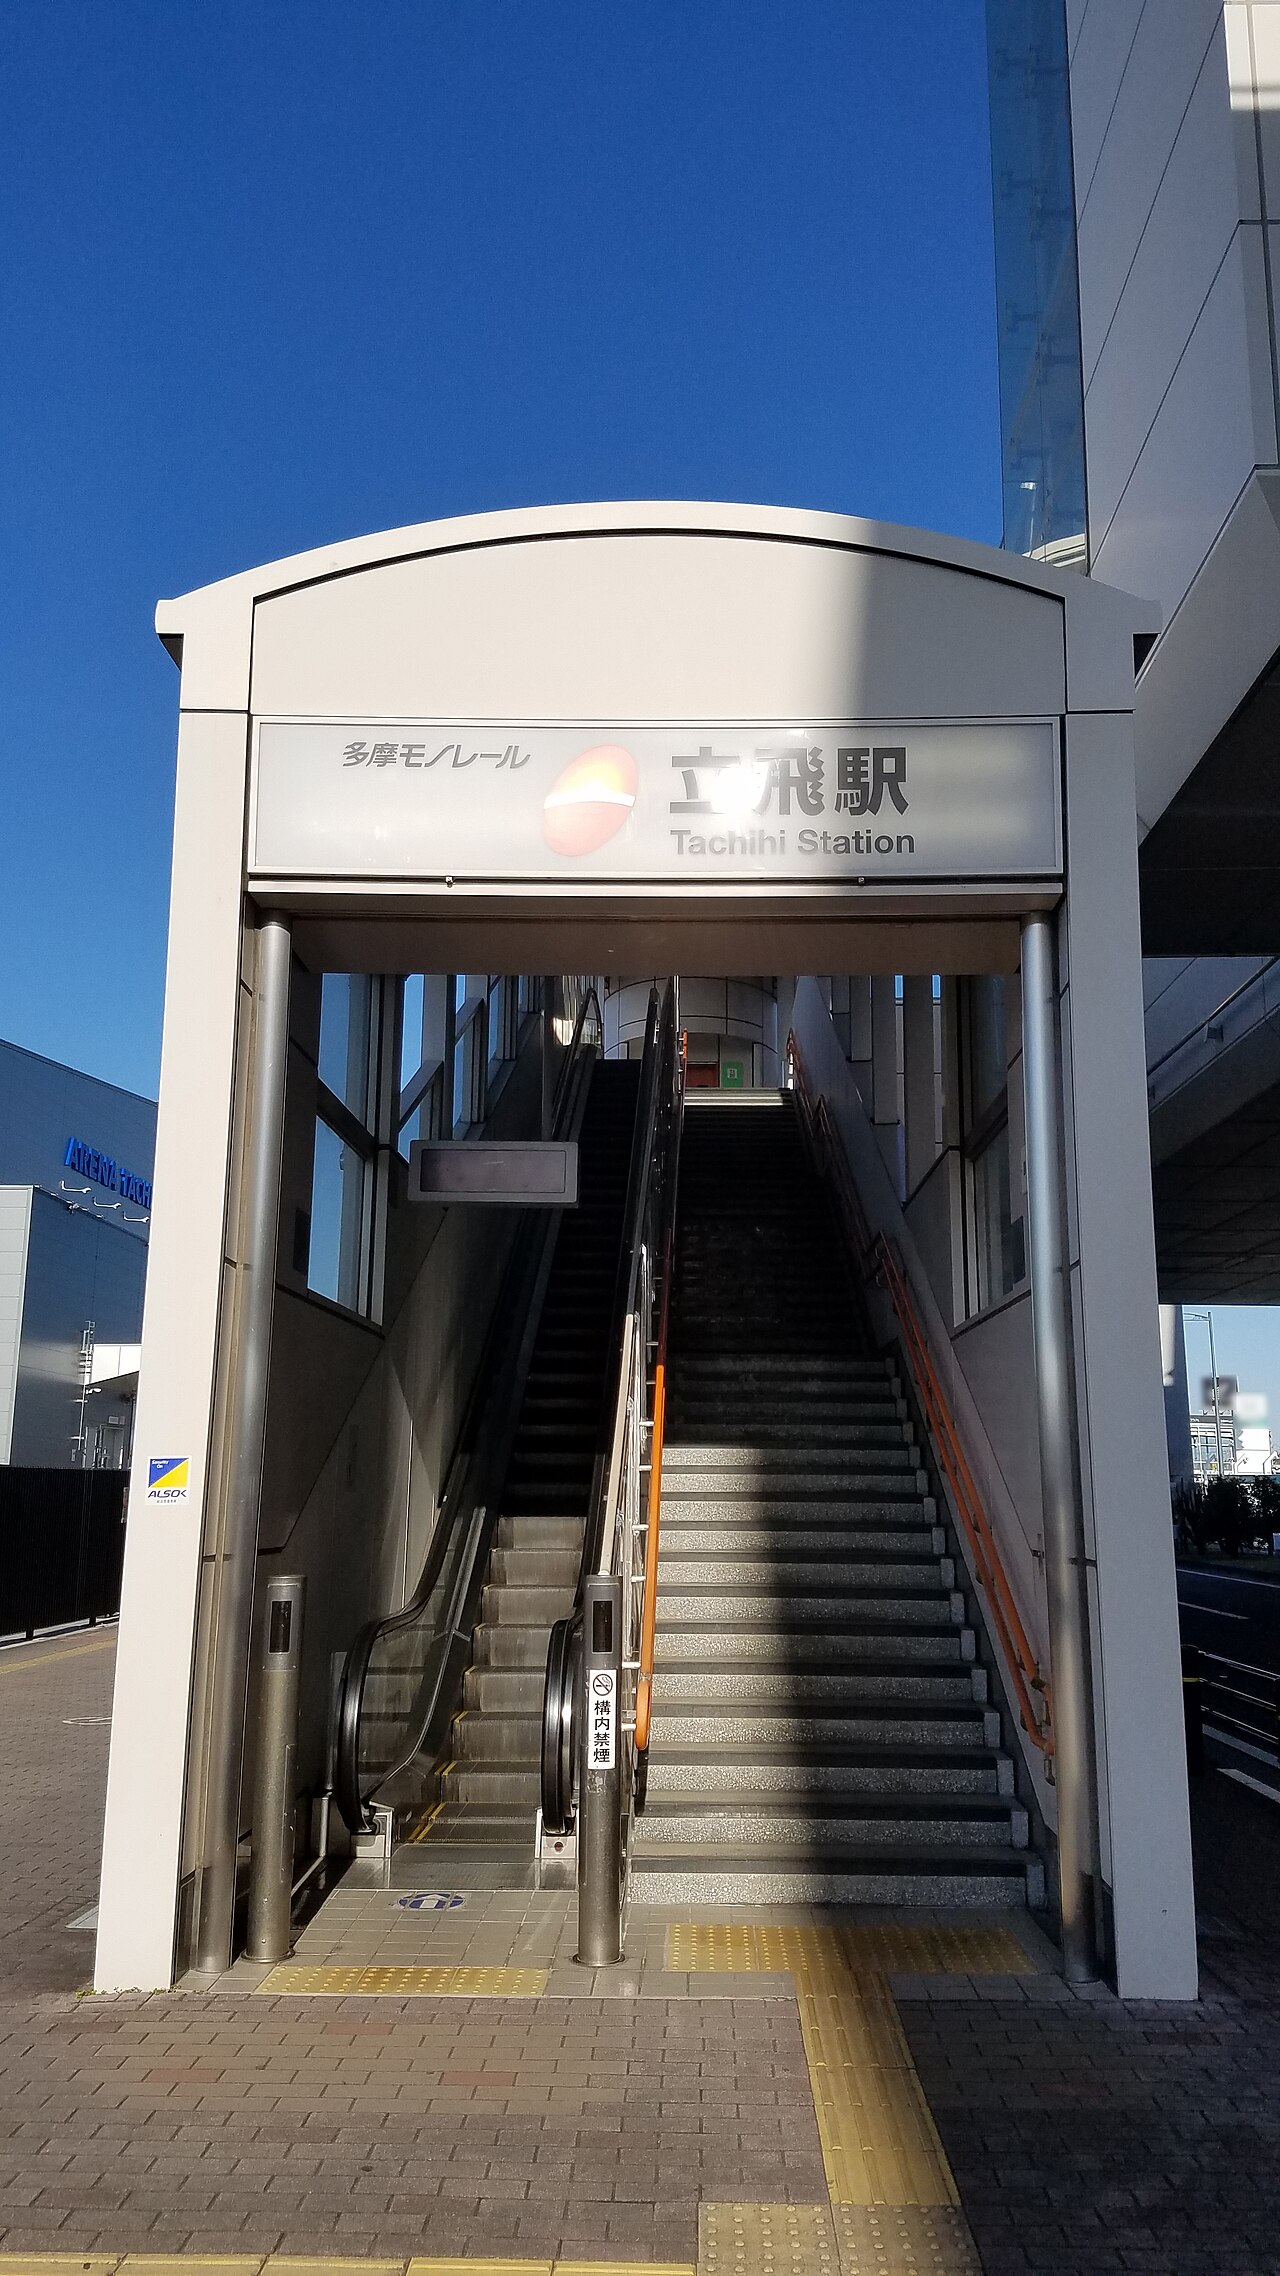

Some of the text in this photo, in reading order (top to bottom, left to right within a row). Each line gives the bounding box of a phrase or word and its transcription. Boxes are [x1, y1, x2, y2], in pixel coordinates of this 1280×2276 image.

[342, 741, 532, 769] 多摩モノレール
[669, 746, 910, 816] 立飛駅
[669, 828, 916, 855] Tachihi Station
[64, 1135, 118, 1191] ARENA
[147, 1489, 187, 1498] ALSOK
[593, 1700, 611, 1763] 構内禁煙
